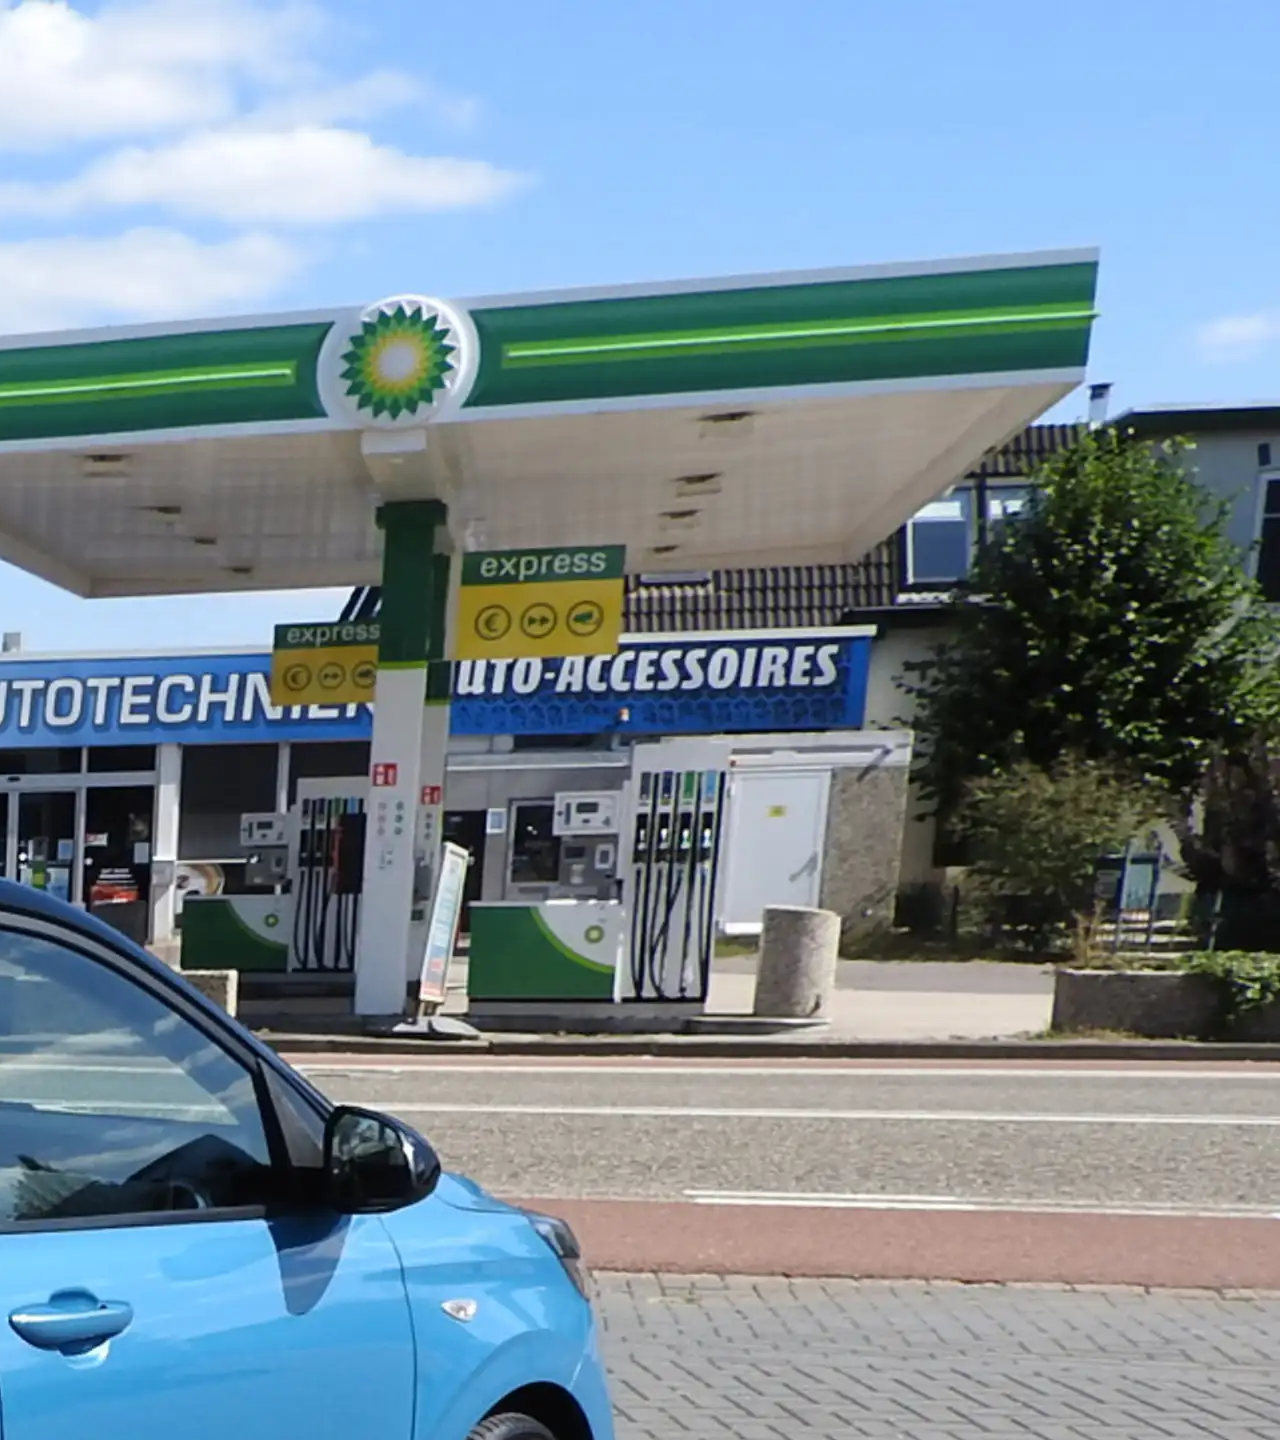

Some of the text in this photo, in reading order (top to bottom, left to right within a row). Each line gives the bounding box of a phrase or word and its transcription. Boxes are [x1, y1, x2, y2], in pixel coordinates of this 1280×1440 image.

[479, 551, 607, 581] express
[286, 623, 381, 647] express
[456, 644, 840, 696] UTO-ACCESSOIRES
